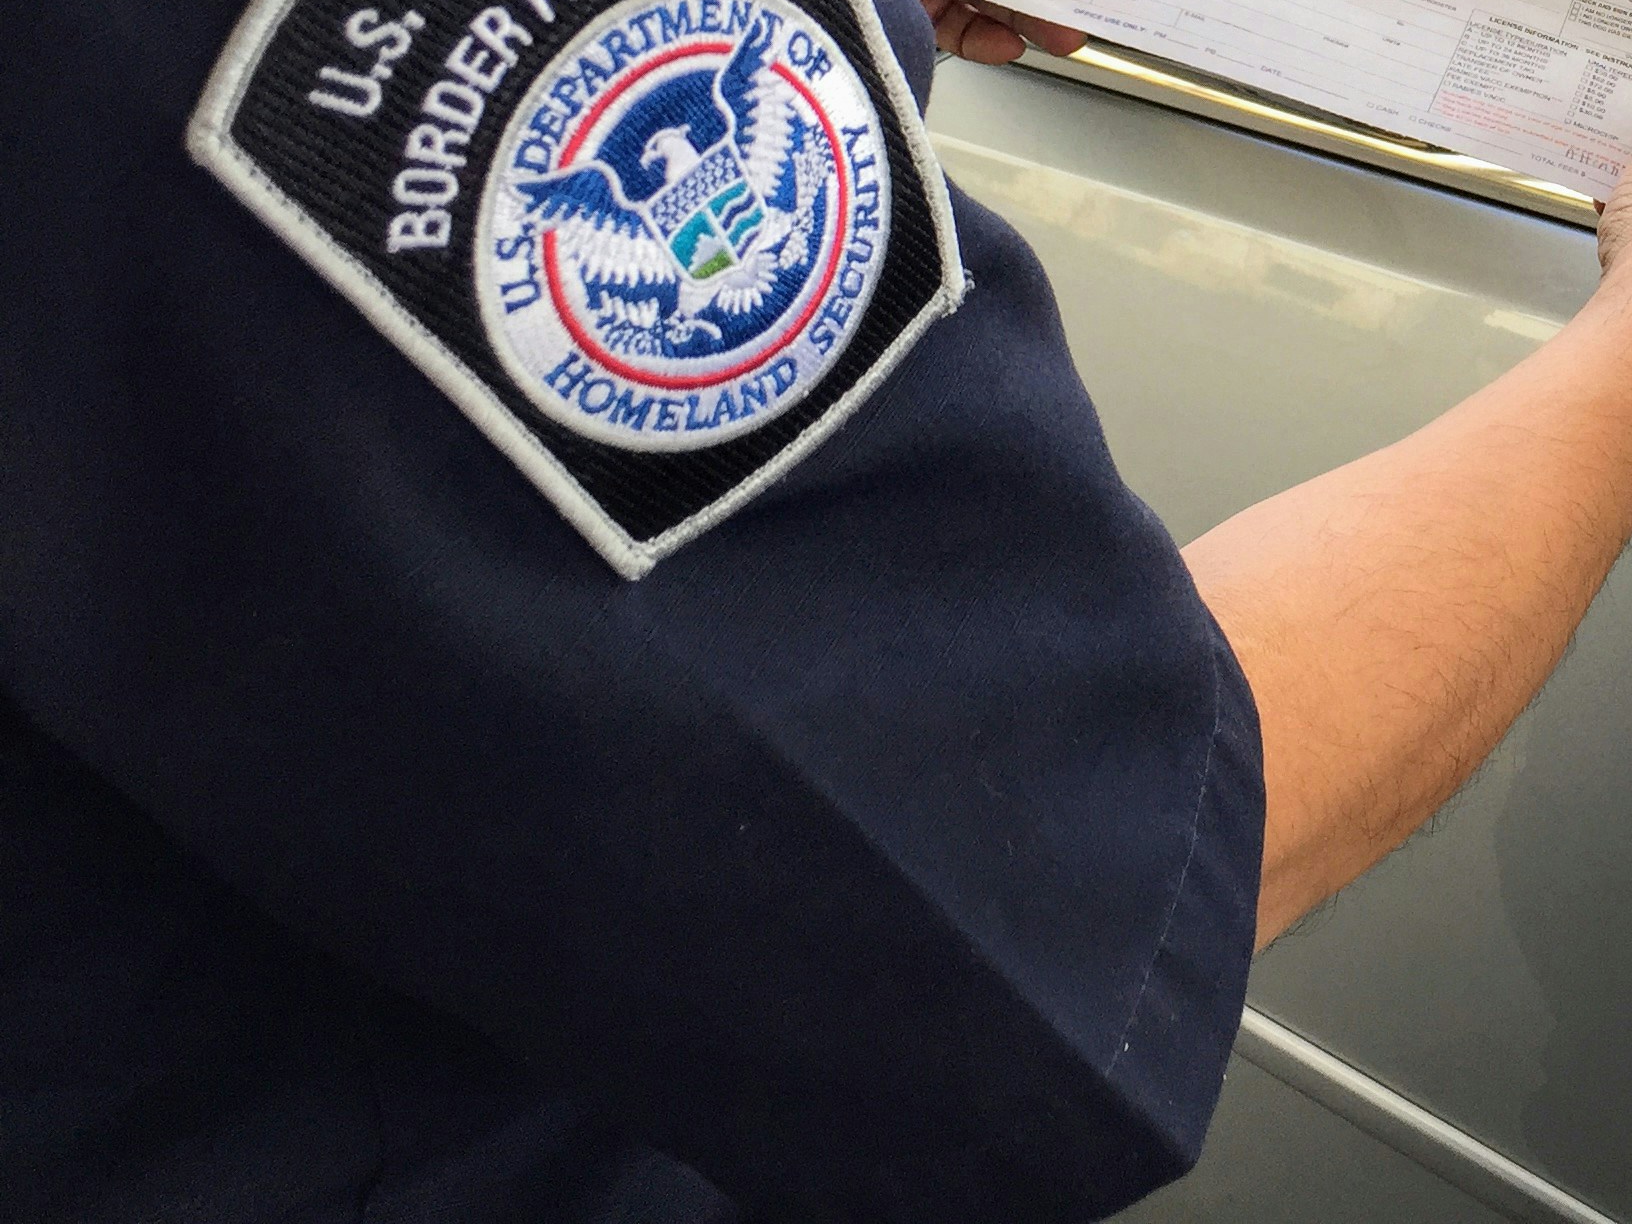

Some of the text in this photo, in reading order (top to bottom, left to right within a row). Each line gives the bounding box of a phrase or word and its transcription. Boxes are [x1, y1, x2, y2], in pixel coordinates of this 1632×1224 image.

[308, 7, 427, 117] U.S.
[386, 15, 534, 254] BORDER
[1488, 15, 1579, 50] LICENSE INFORMATION
[495, 220, 543, 315] U.S.
[787, 29, 834, 82] OF
[542, 123, 882, 434] HOMELAND SECURITY
